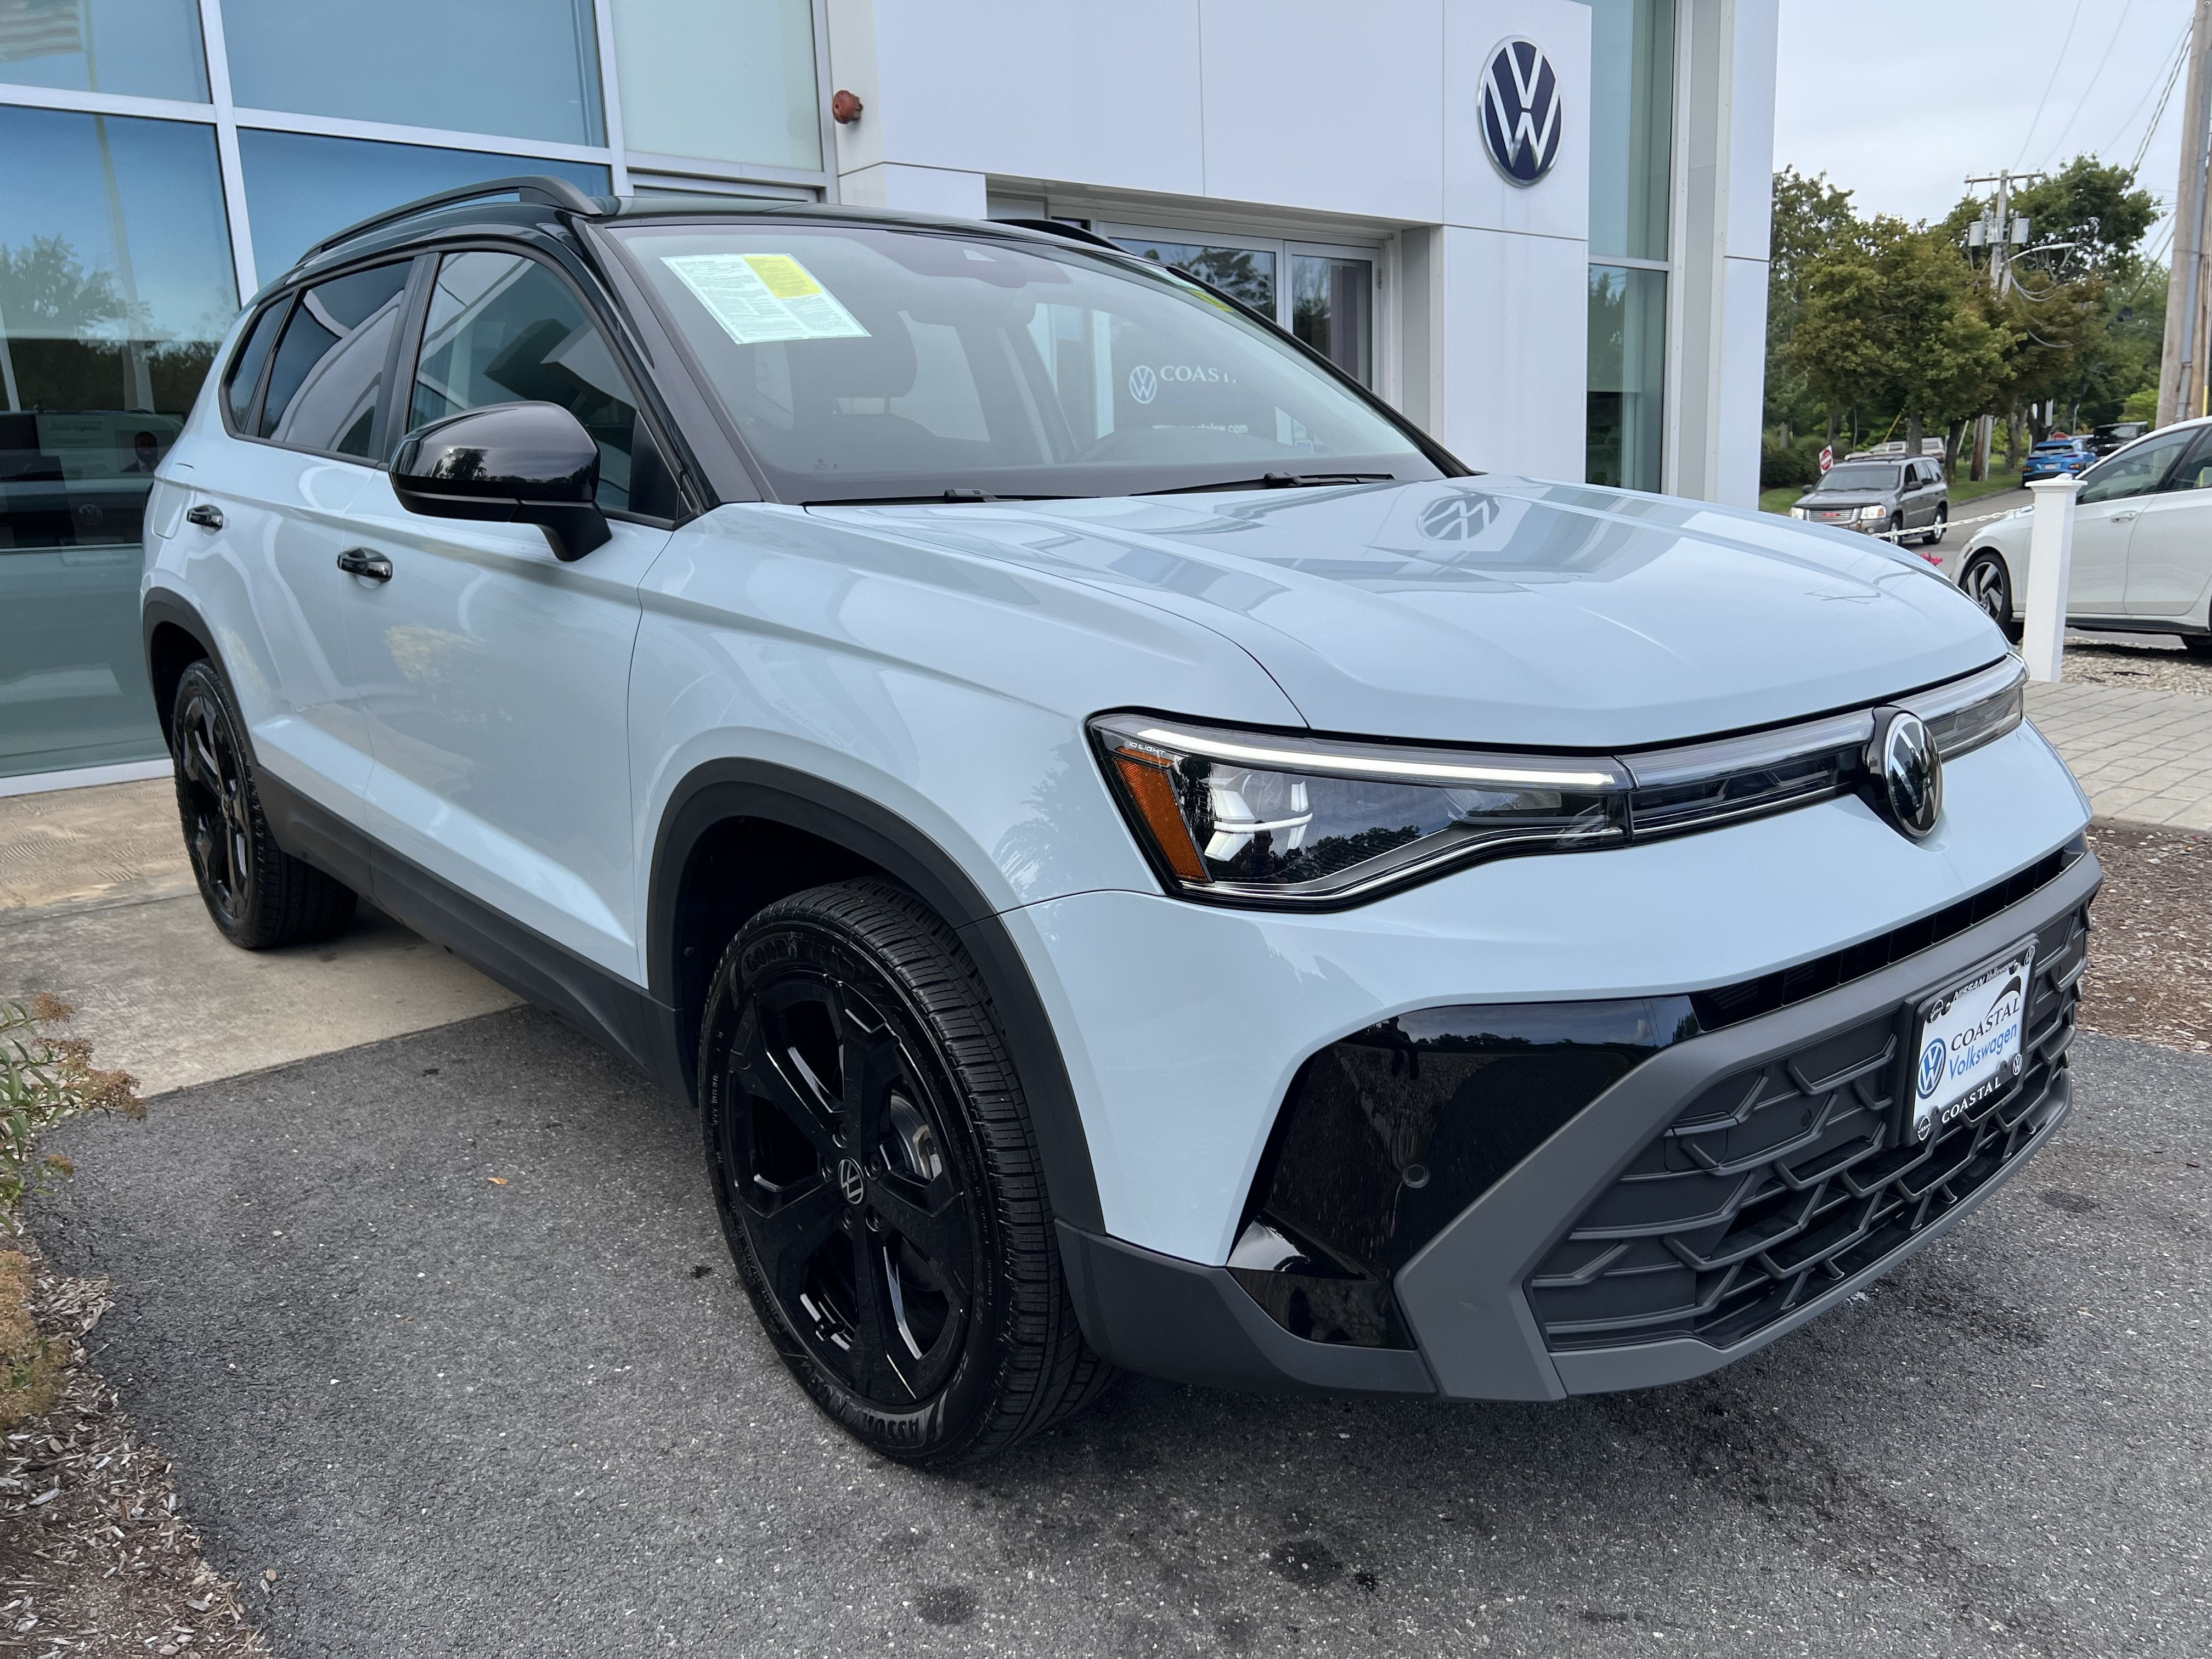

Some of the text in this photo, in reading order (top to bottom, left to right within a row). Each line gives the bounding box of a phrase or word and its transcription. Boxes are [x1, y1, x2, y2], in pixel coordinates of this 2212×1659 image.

[1477, 35, 1562, 187] VW
[1953, 977, 1985, 1001] NISSAN
[1951, 997, 2019, 1051] COASTAL
[1949, 1024, 2017, 1080] Volkswagen
[1942, 1076, 2001, 1124] COASTAL
